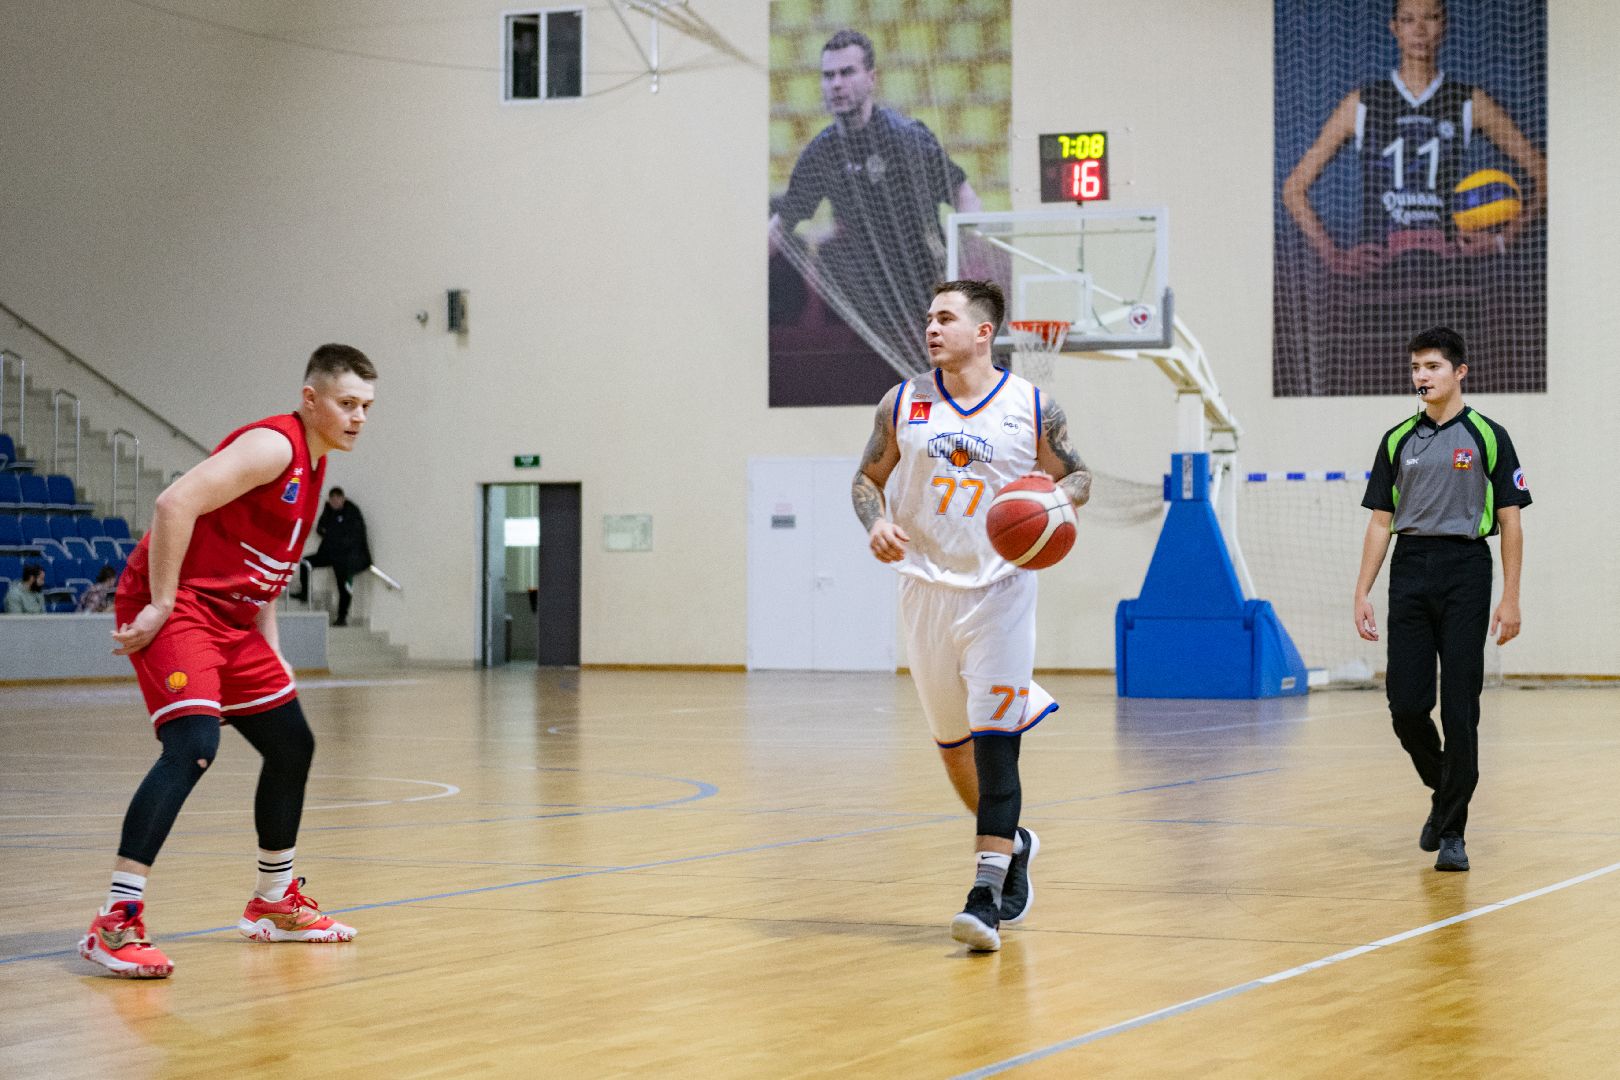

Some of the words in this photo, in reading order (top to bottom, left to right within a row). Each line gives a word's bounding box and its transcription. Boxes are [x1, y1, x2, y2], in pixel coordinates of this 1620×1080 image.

[1058, 134, 1105, 159] 7:08
[1383, 137, 1440, 190] 11
[1073, 161, 1100, 198] 16
[931, 476, 985, 518] 77
